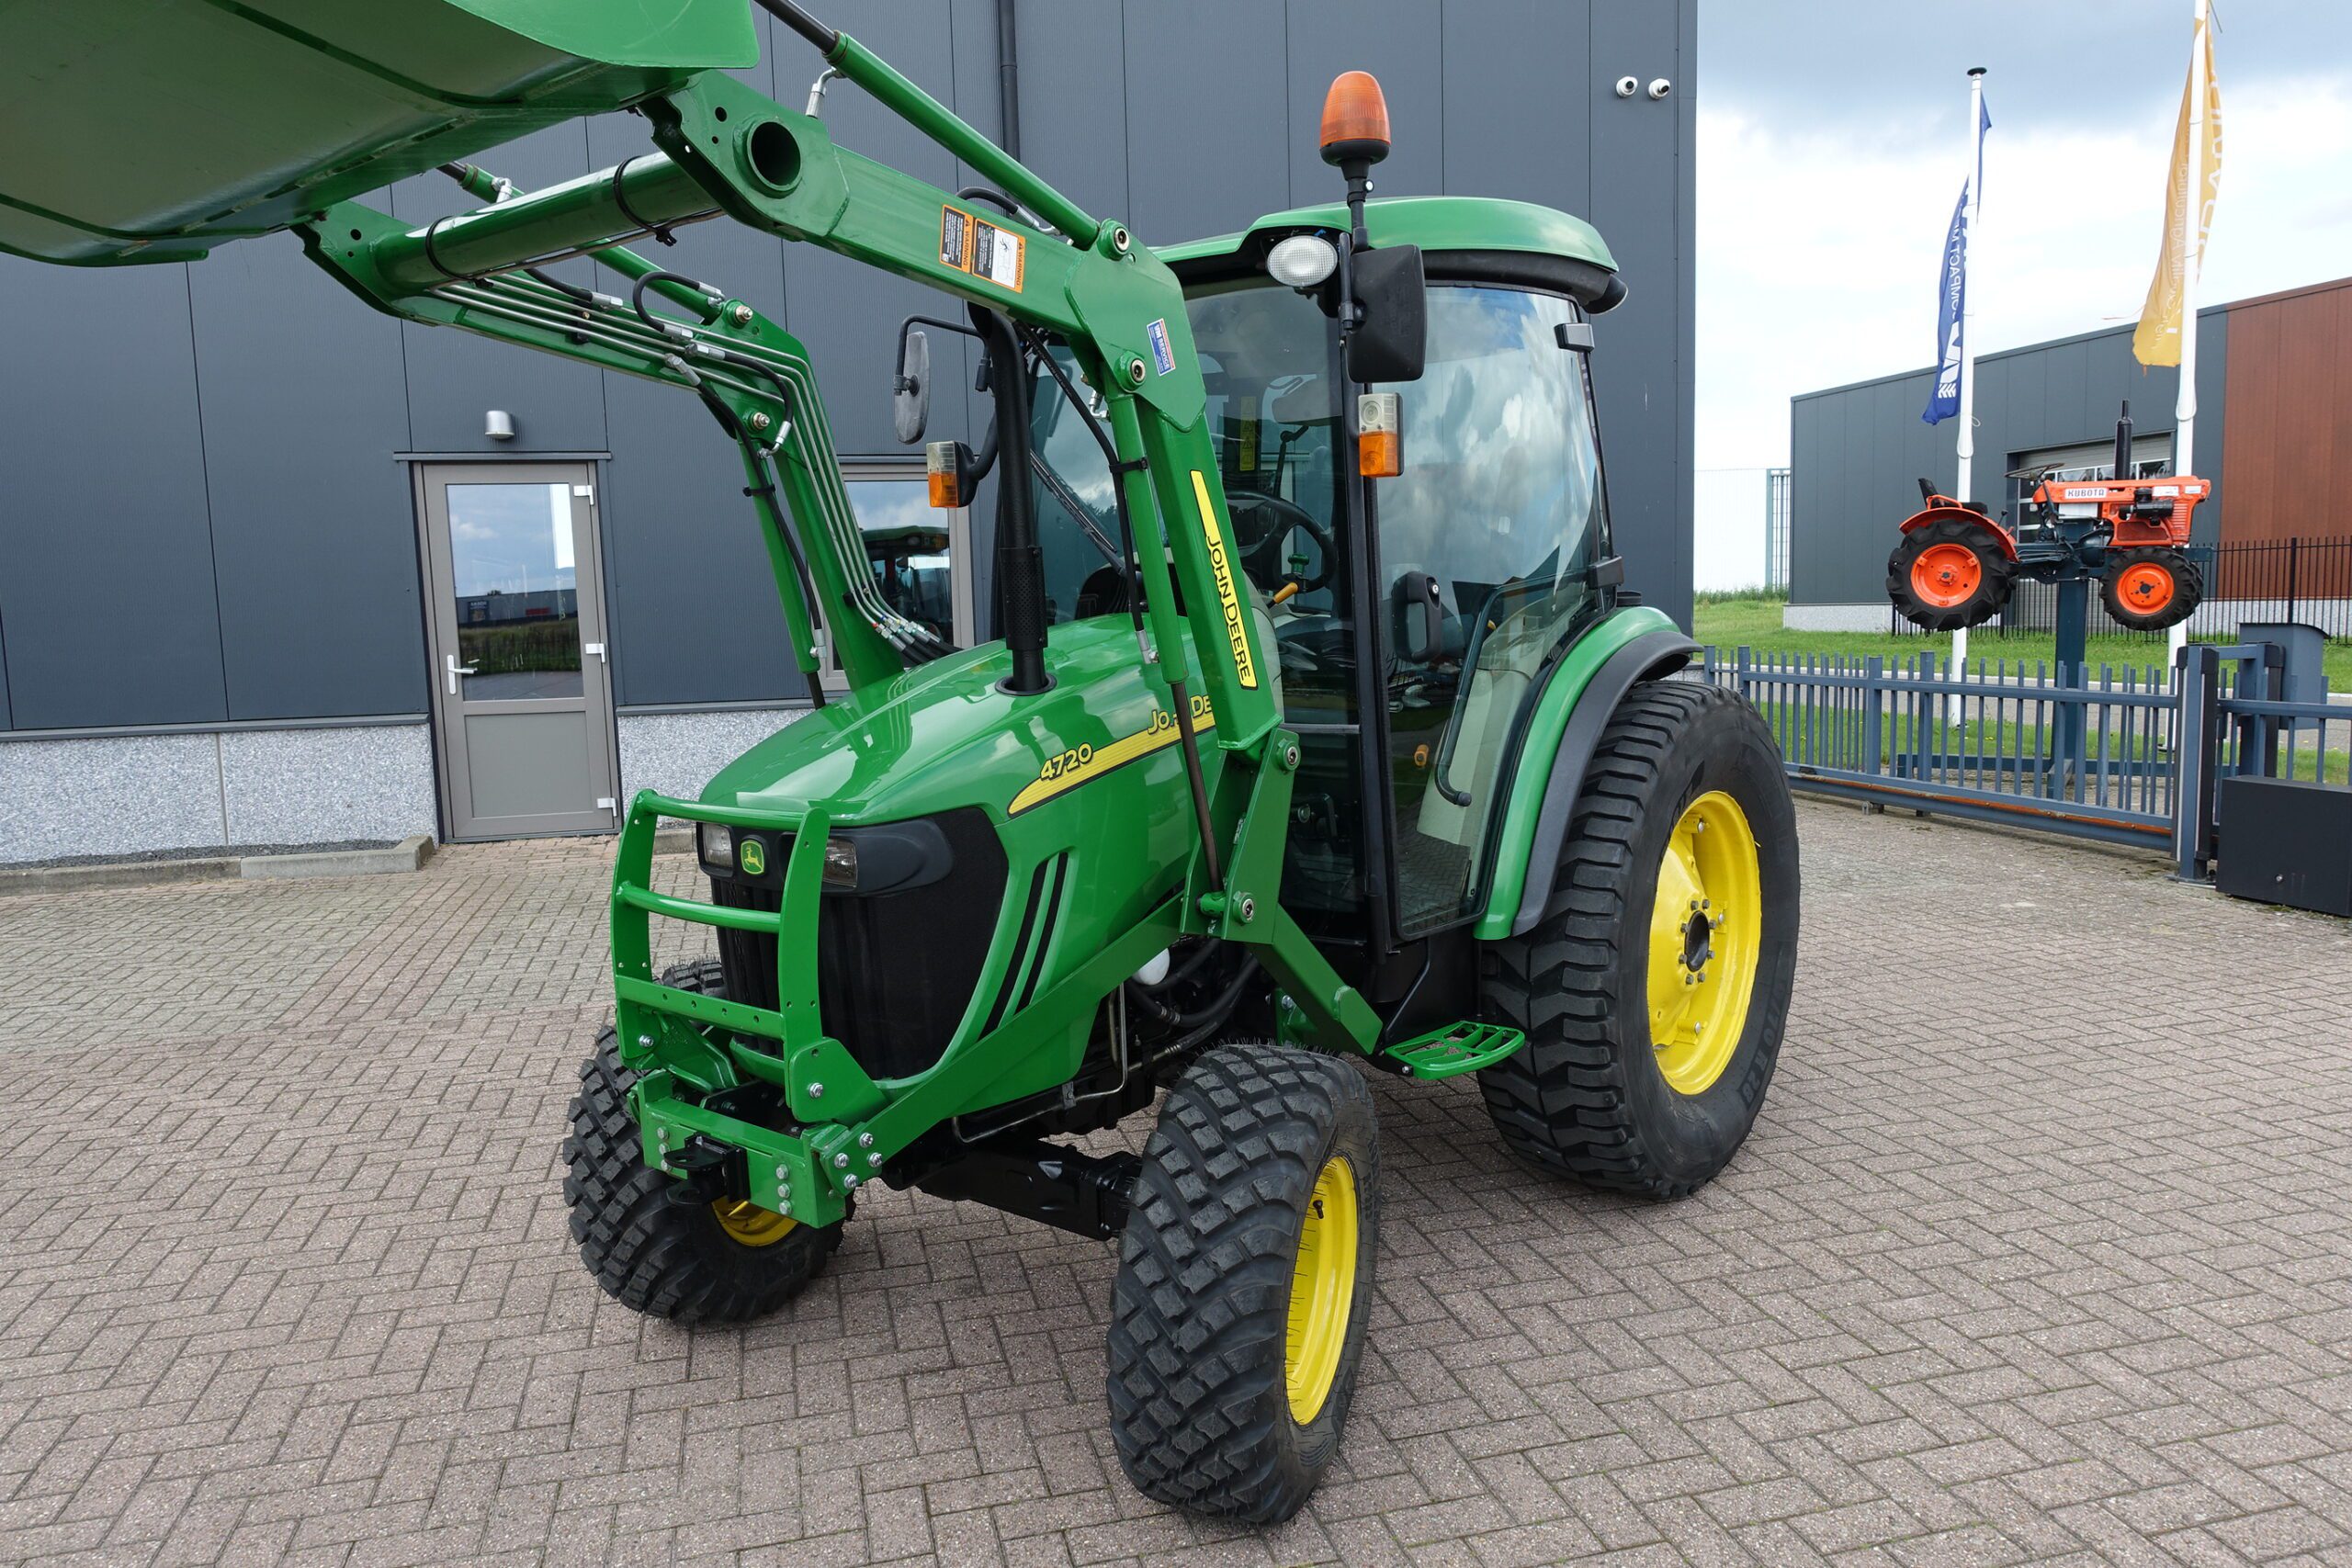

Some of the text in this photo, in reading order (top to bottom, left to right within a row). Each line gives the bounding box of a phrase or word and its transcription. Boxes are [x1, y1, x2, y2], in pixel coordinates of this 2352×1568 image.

[962, 231, 971, 265] WARNING
[1015, 252, 1023, 286] WARNING
[1154, 324, 1162, 339] VM
[1159, 338, 1170, 370] SERVICE
[2067, 488, 2105, 498] KUBOTA
[1207, 536, 1250, 682] JOHN DEERE
[1040, 742, 1094, 781] 4720
